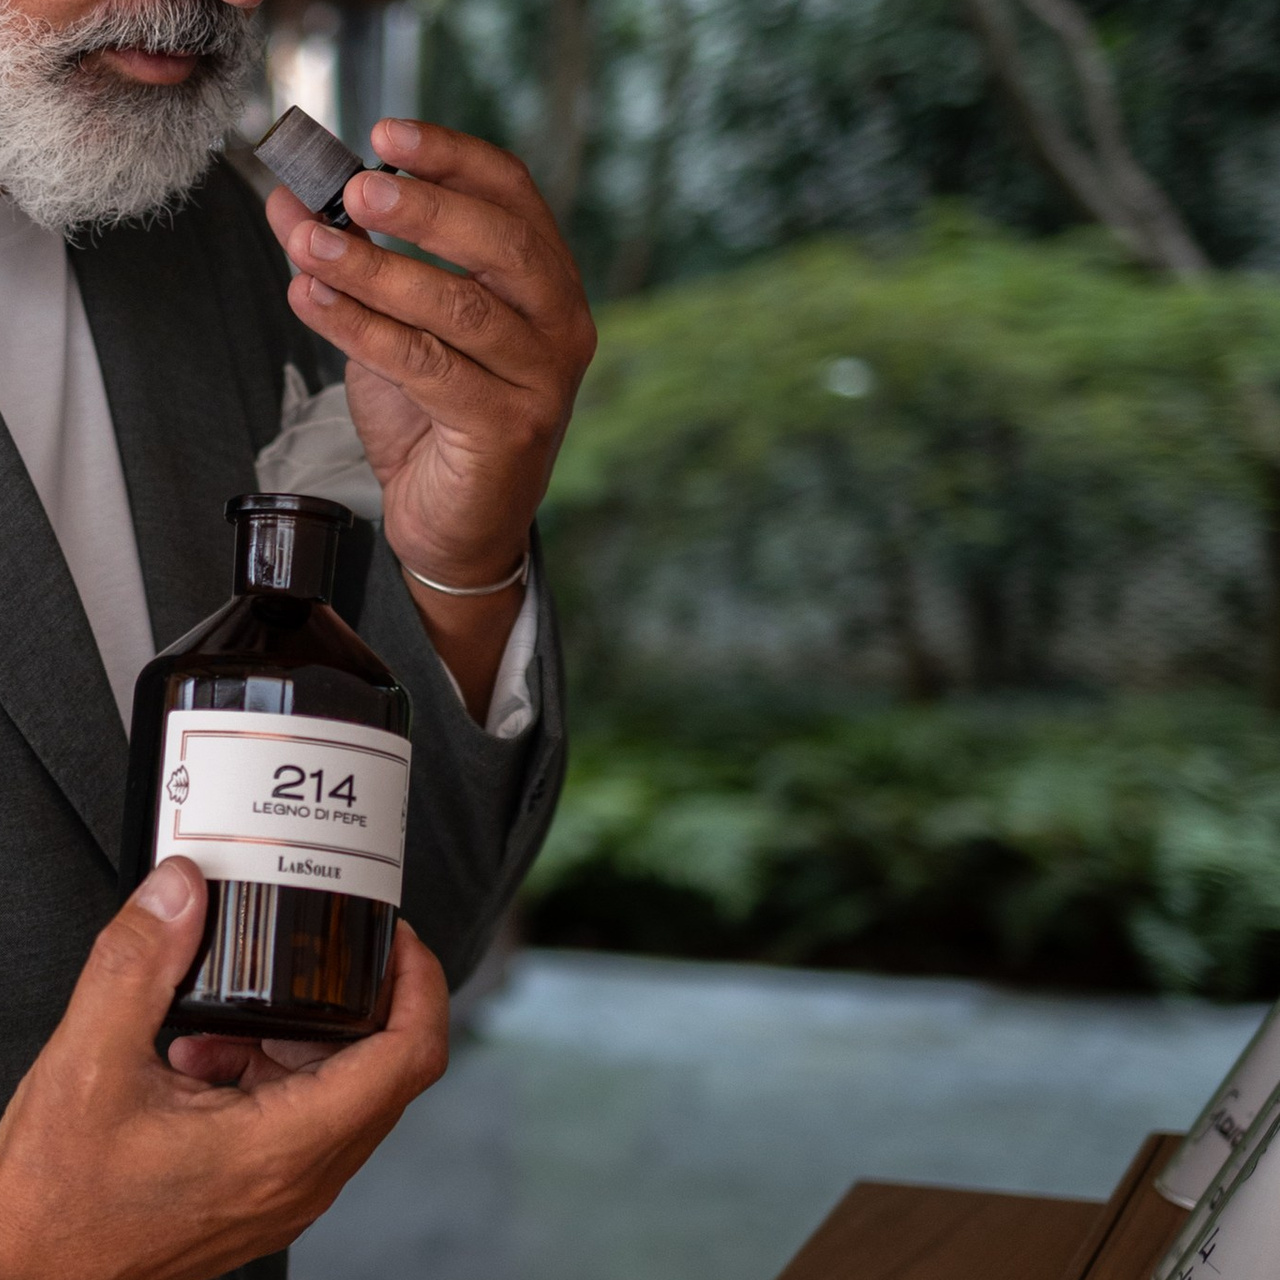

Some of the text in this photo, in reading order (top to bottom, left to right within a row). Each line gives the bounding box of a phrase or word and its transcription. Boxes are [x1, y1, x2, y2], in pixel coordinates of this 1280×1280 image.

[272, 765, 356, 808] 214
[253, 801, 367, 827] LEGNO DI PEPE
